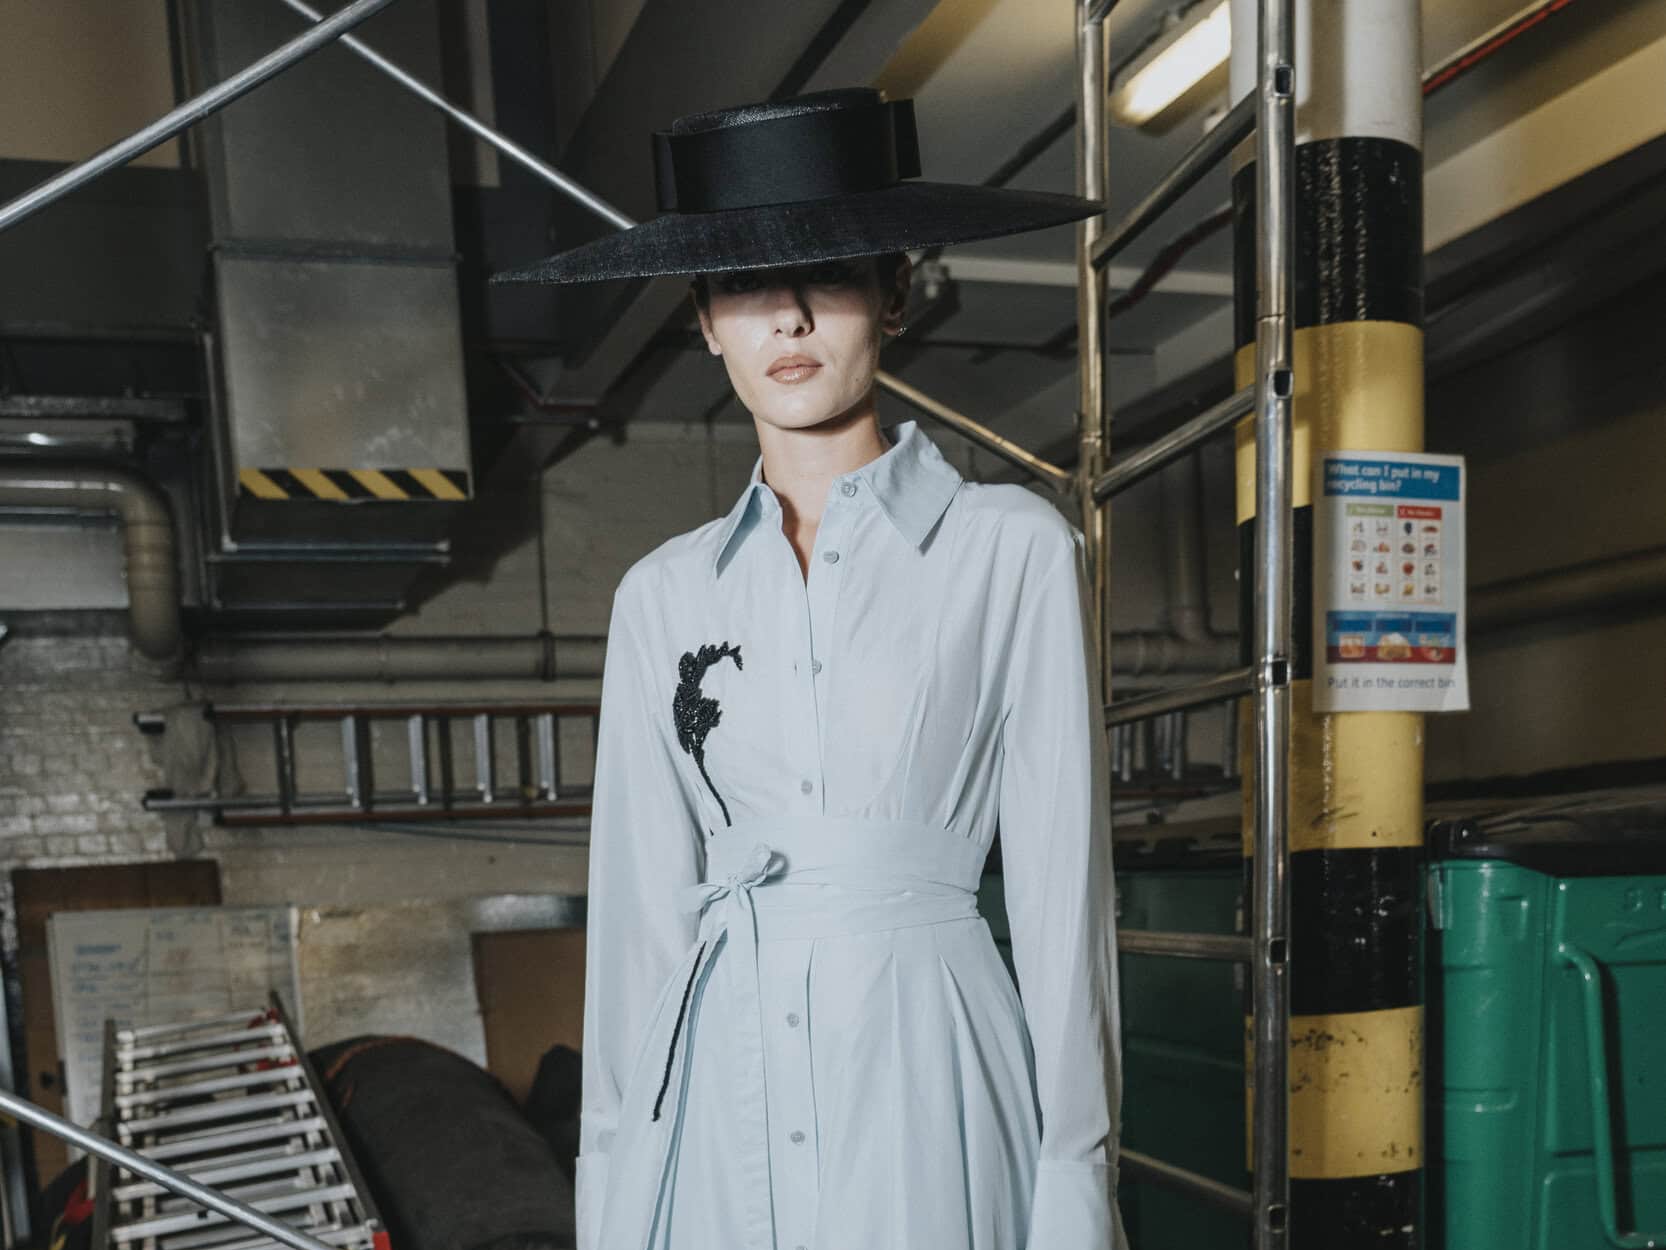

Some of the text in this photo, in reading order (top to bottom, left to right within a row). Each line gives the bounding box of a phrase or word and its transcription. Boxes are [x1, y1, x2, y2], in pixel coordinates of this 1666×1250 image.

[1327, 463, 1360, 477] What
[1362, 466, 1381, 477] can
[1391, 467, 1410, 480] put
[1412, 466, 1422, 479] in
[1424, 470, 1440, 484] my
[1327, 478, 1402, 493] recycling bin?
[1328, 676, 1347, 689] Put
[1351, 676, 1360, 689] it
[1363, 677, 1373, 689] in
[1376, 676, 1395, 689] the
[1398, 677, 1435, 689] correct
